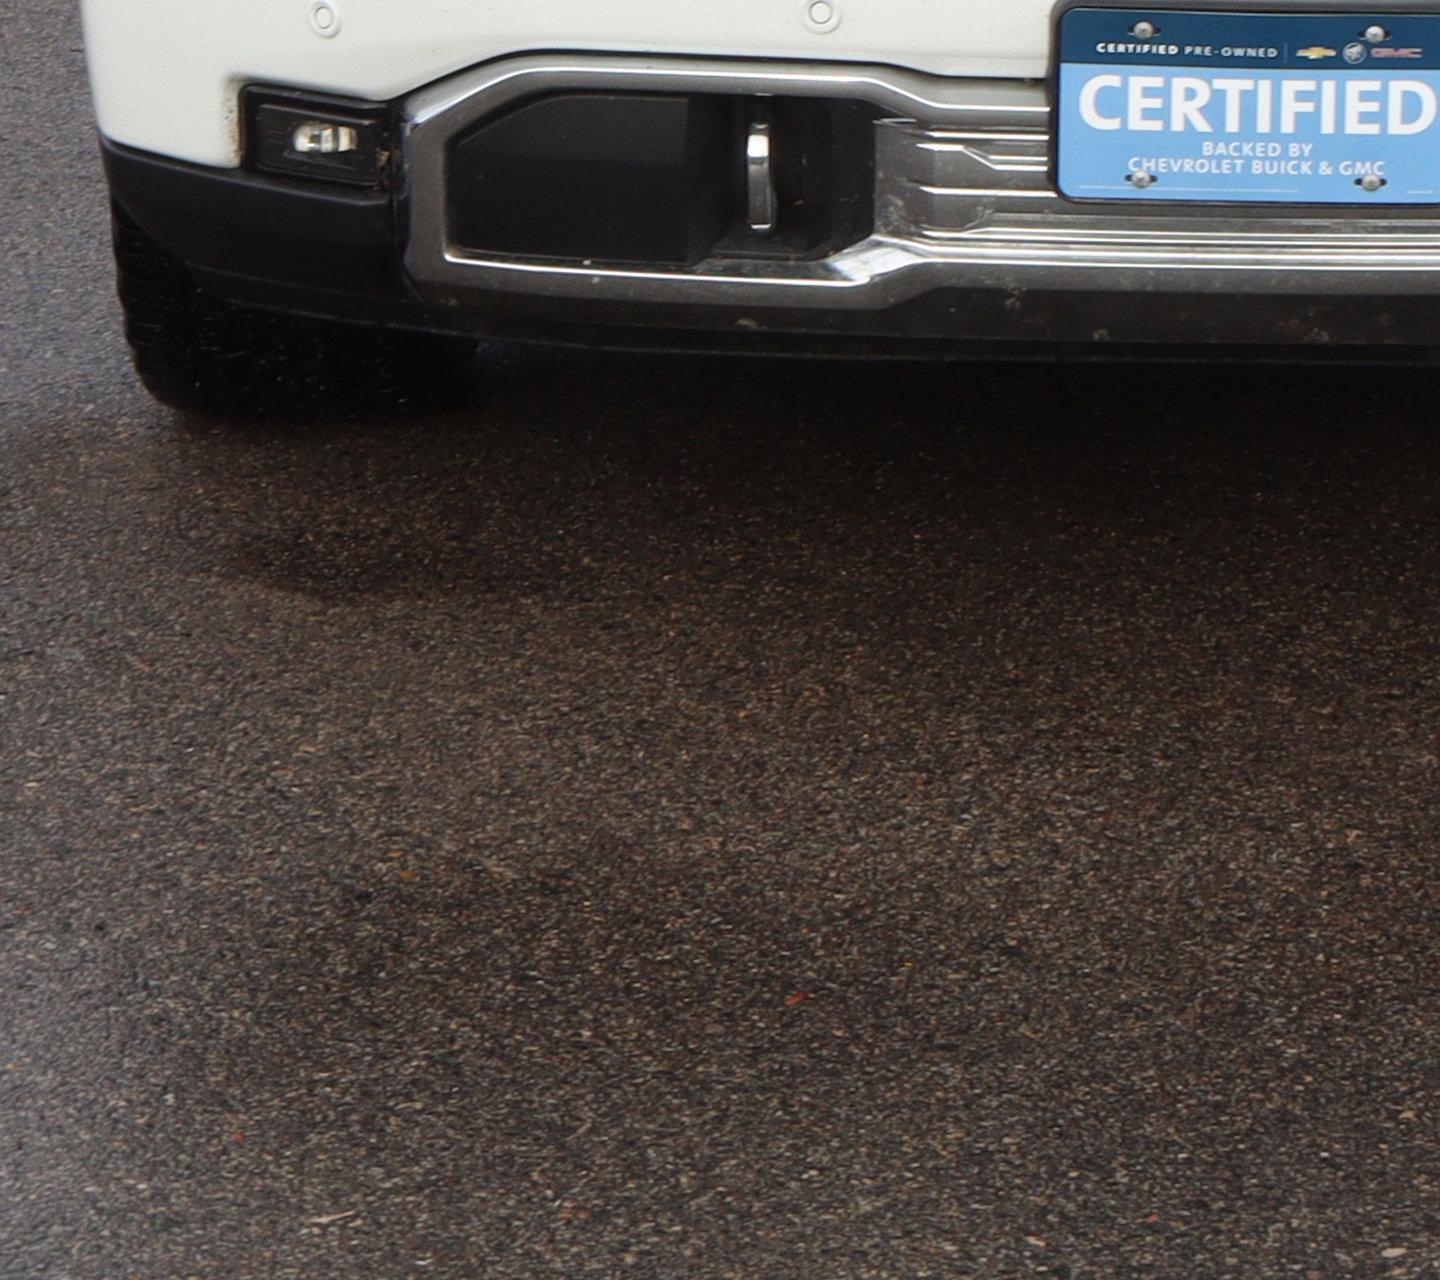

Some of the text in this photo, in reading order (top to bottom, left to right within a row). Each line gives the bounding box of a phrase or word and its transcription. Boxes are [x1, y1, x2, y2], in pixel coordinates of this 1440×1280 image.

[1096, 41, 1423, 59] CERTIFIED PRE-OWNED GMC
[1077, 74, 1438, 137] CERTIFIED
[1201, 141, 1314, 159] BACKED BY
[1127, 157, 1387, 177] CHEVROLET BUICK & GMC
